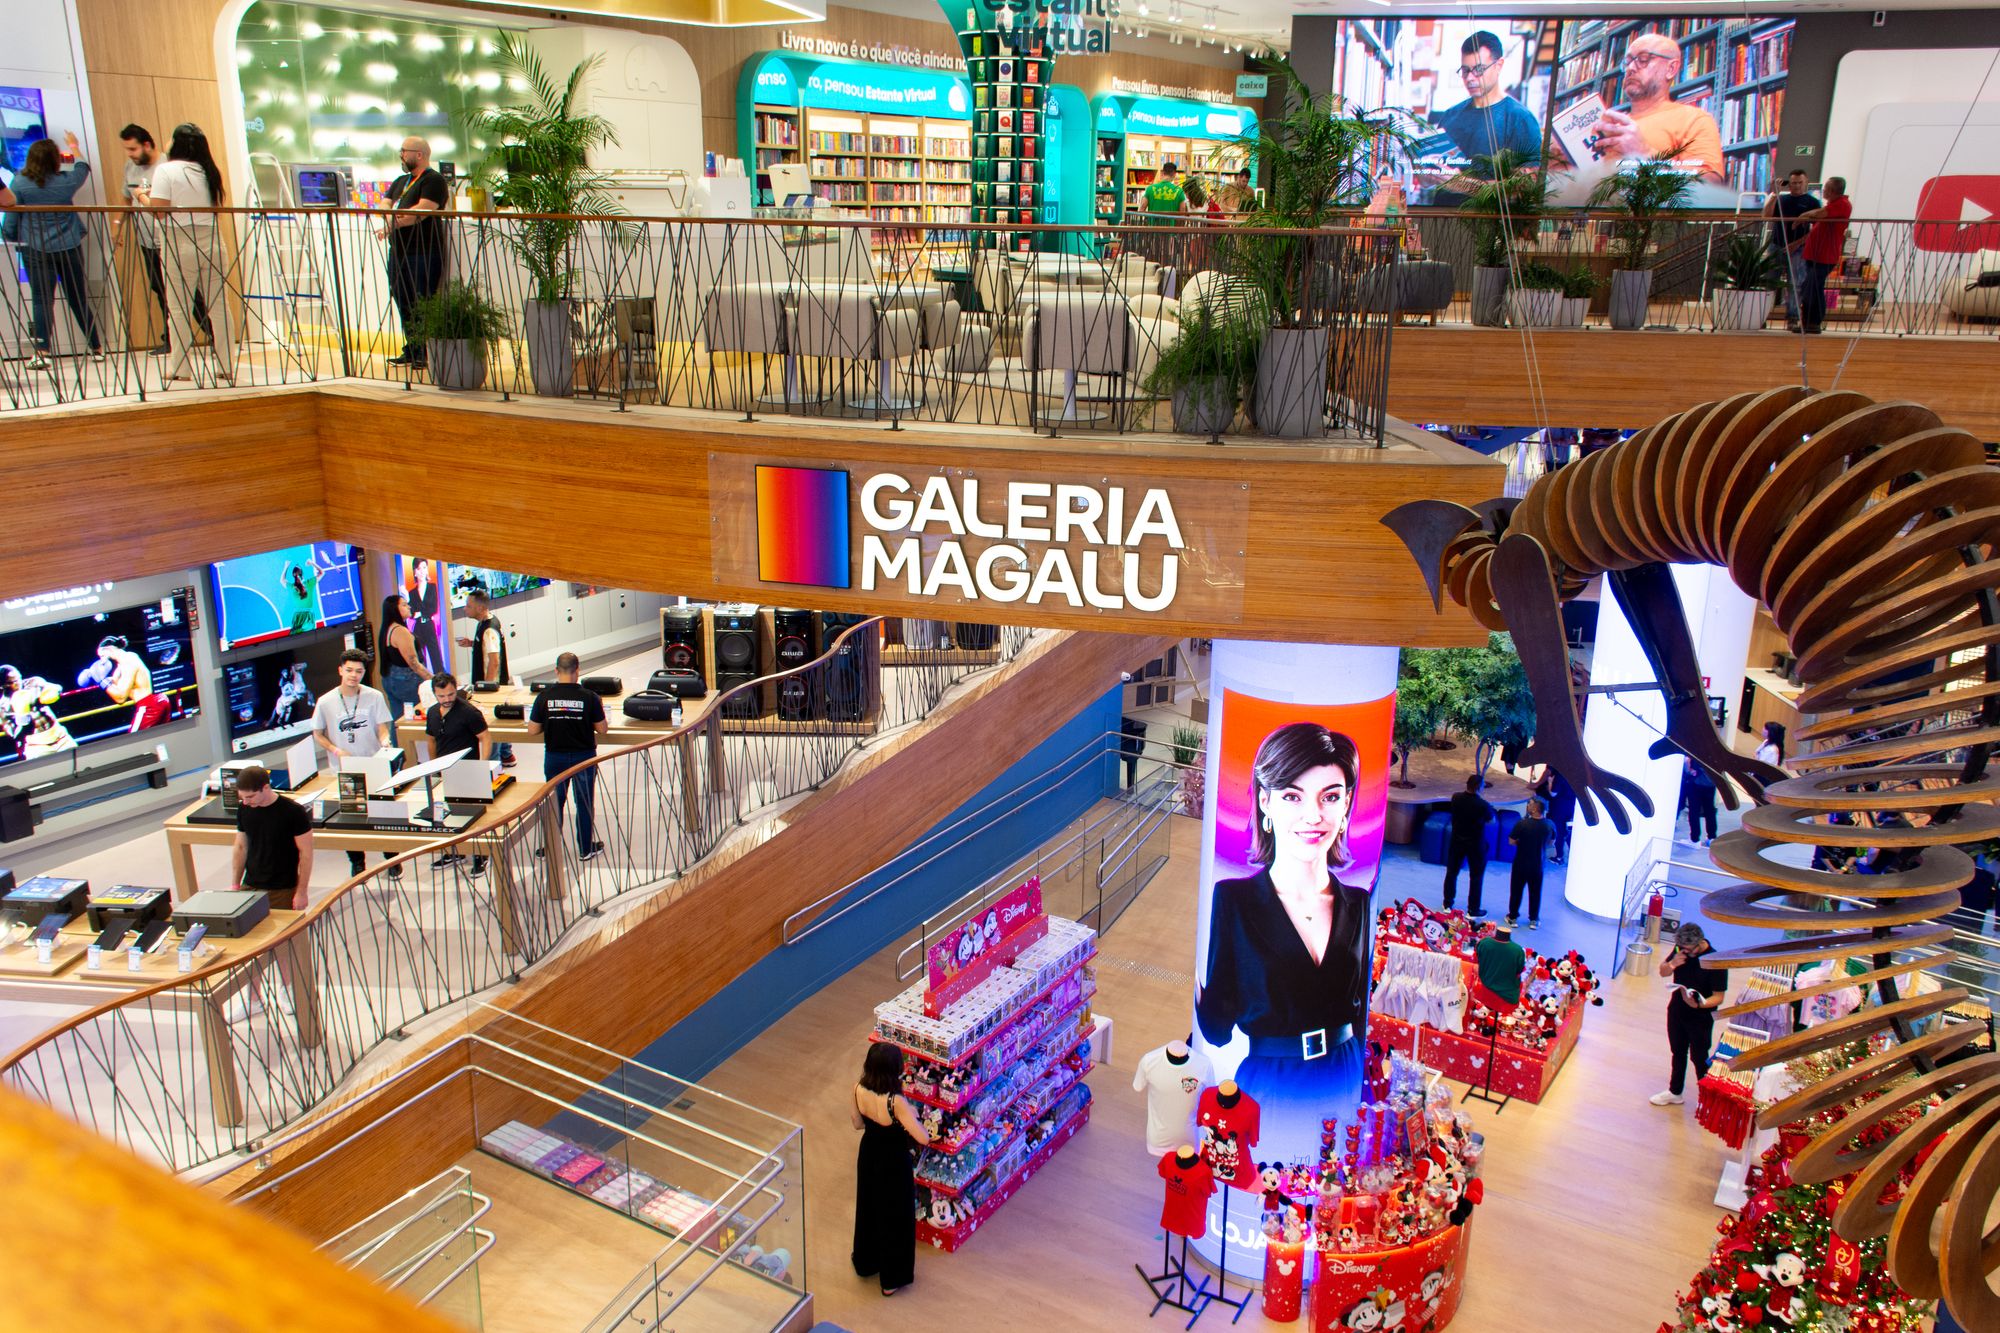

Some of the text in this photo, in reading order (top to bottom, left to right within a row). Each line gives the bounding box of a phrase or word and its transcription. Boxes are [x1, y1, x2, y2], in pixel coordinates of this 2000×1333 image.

[782, 30, 815, 52] Livro
[816, 38, 849, 56] novo
[850, 39, 858, 57] é
[860, 45, 868, 58] o
[869, 47, 892, 63] que
[894, 48, 921, 65] você
[922, 50, 954, 69] ainda
[997, 15, 1111, 53] virtual
[824, 79, 864, 98] pensou
[865, 85, 903, 102] Estante
[903, 86, 937, 102] Virtual
[1112, 76, 1141, 92] Pensou
[1160, 84, 1187, 98] pensou
[1186, 86, 1212, 102] Estante
[1211, 89, 1234, 103] Virtual
[1239, 82, 1264, 90] caixa
[860, 472, 1185, 549] GALERIA
[861, 534, 1179, 612] MAGALU
